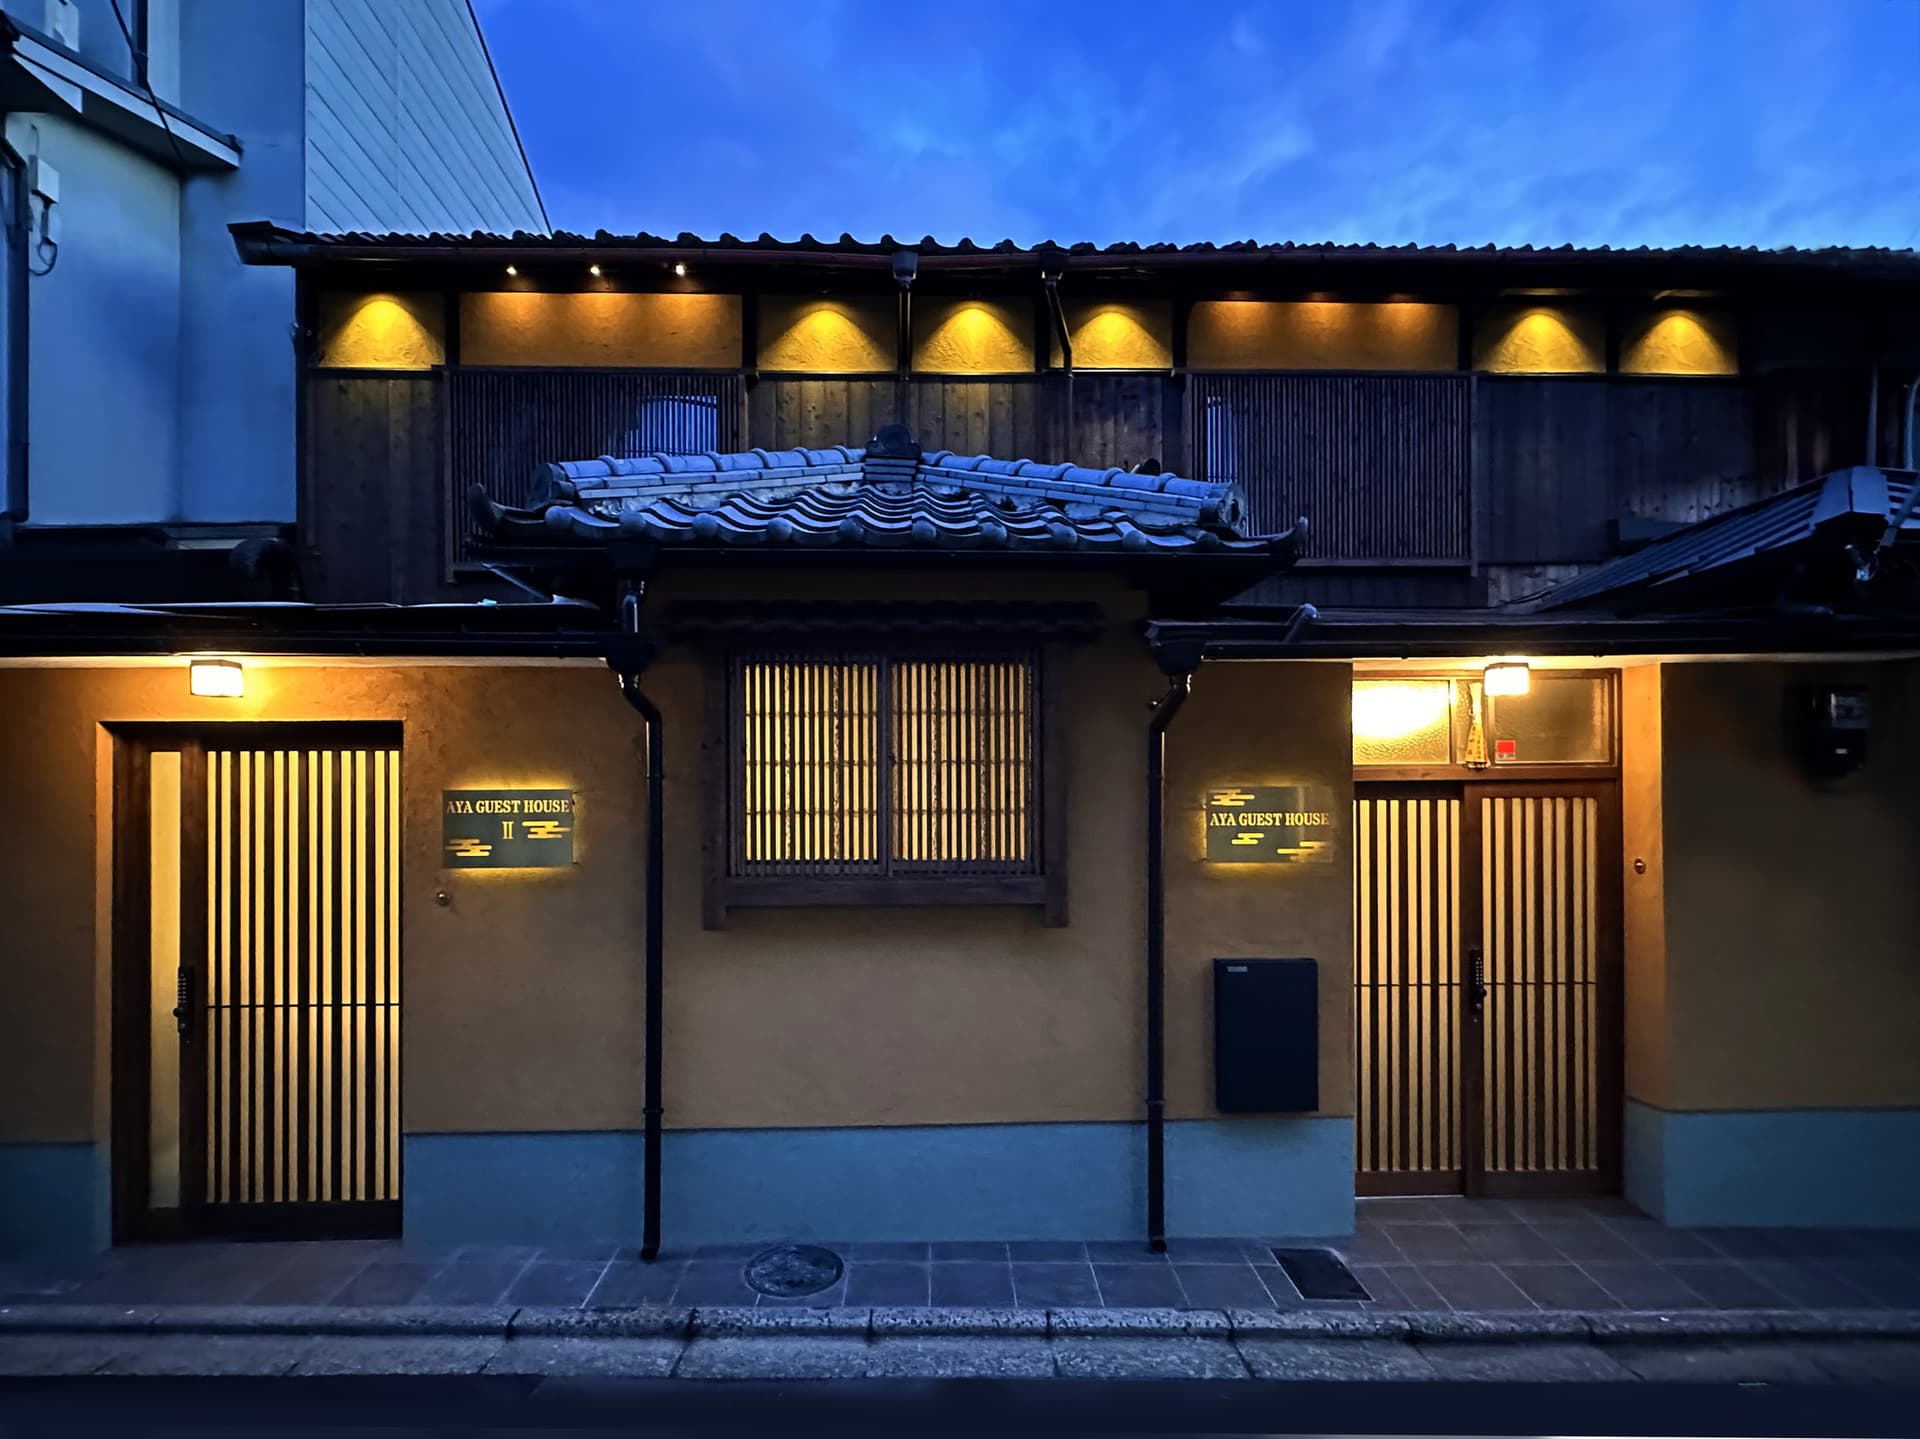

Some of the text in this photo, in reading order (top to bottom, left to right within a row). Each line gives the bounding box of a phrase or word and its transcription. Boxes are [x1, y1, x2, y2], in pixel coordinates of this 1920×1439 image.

[447, 800, 569, 814] AYA GUEST HOUSE
[1210, 813, 1329, 826] AYA GUEST HOUSE
